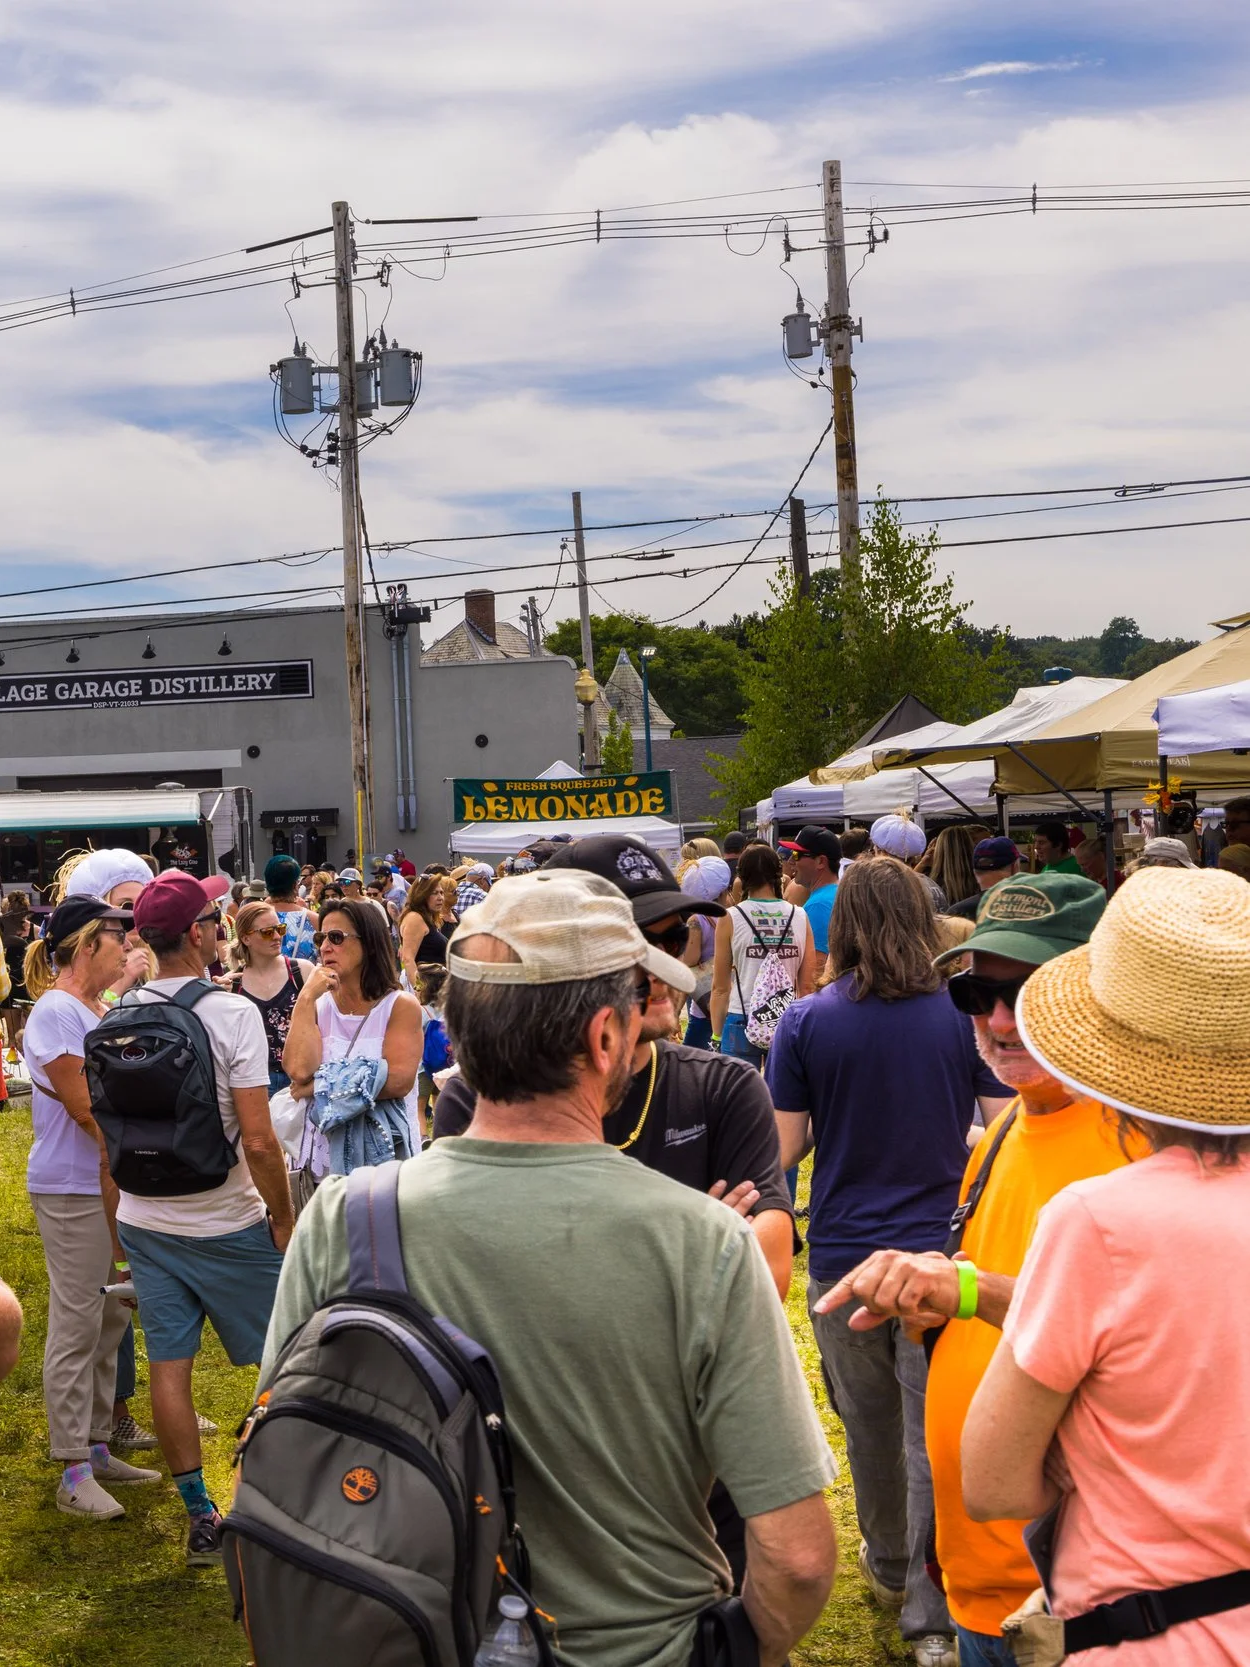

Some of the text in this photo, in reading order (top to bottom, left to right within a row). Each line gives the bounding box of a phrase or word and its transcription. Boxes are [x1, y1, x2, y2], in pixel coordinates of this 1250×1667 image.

[54, 679, 142, 701] GARAGE
[149, 672, 277, 695] DISTILLERY
[93, 700, 139, 708] DSP-VT-21033
[505, 778, 617, 792] FRESH SQUEEZED
[462, 787, 666, 821] LEMONADE
[274, 816, 285, 824] 107
[288, 815, 308, 823] DEPOT
[748, 948, 764, 957] RV
